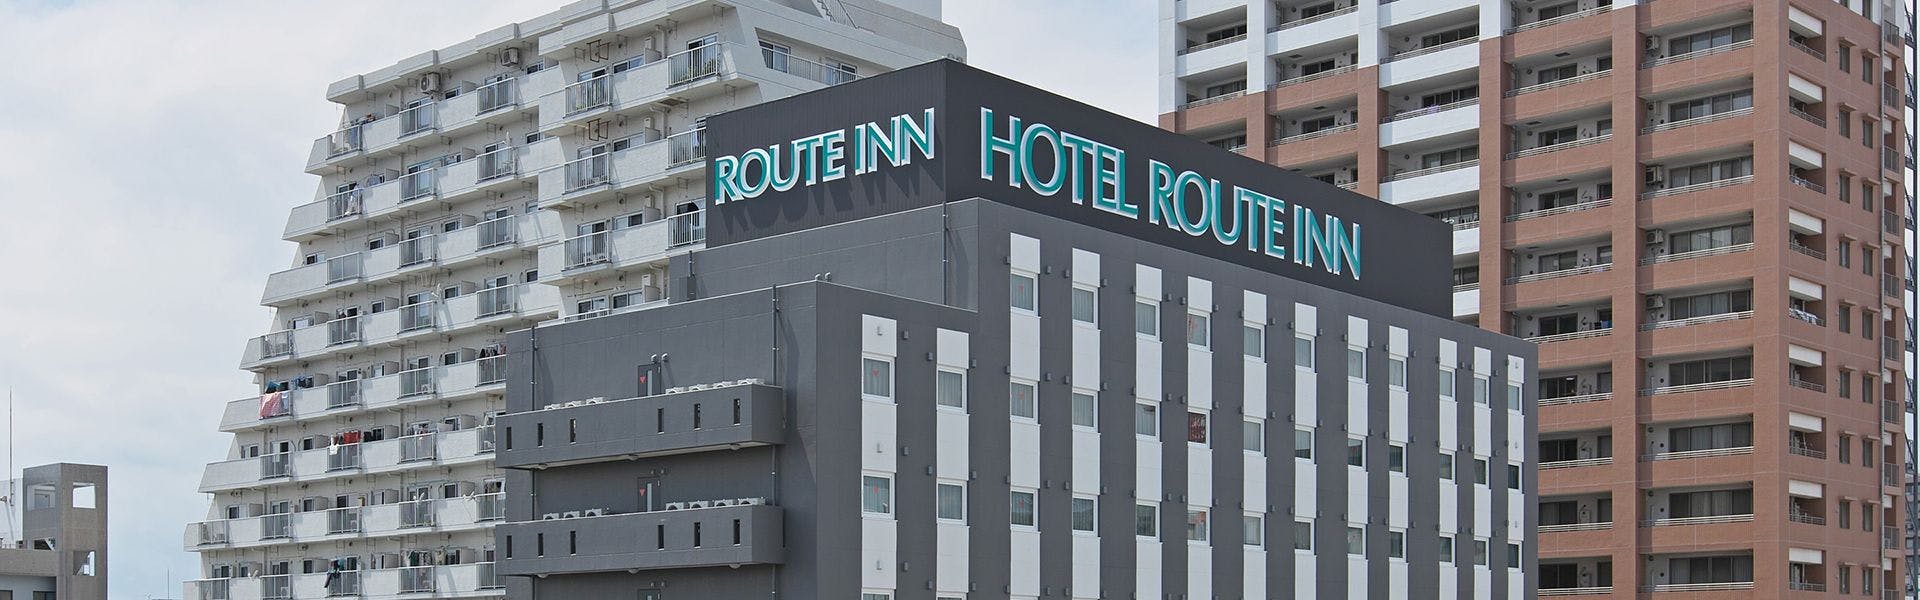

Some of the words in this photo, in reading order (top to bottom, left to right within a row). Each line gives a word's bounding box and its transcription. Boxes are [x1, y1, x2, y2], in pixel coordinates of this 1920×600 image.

[715, 129, 845, 205] ROUTE
[855, 107, 935, 175] INN
[980, 107, 1138, 220] HOTEL
[1149, 159, 1285, 259] ROUTE
[1293, 204, 1361, 280] INN
